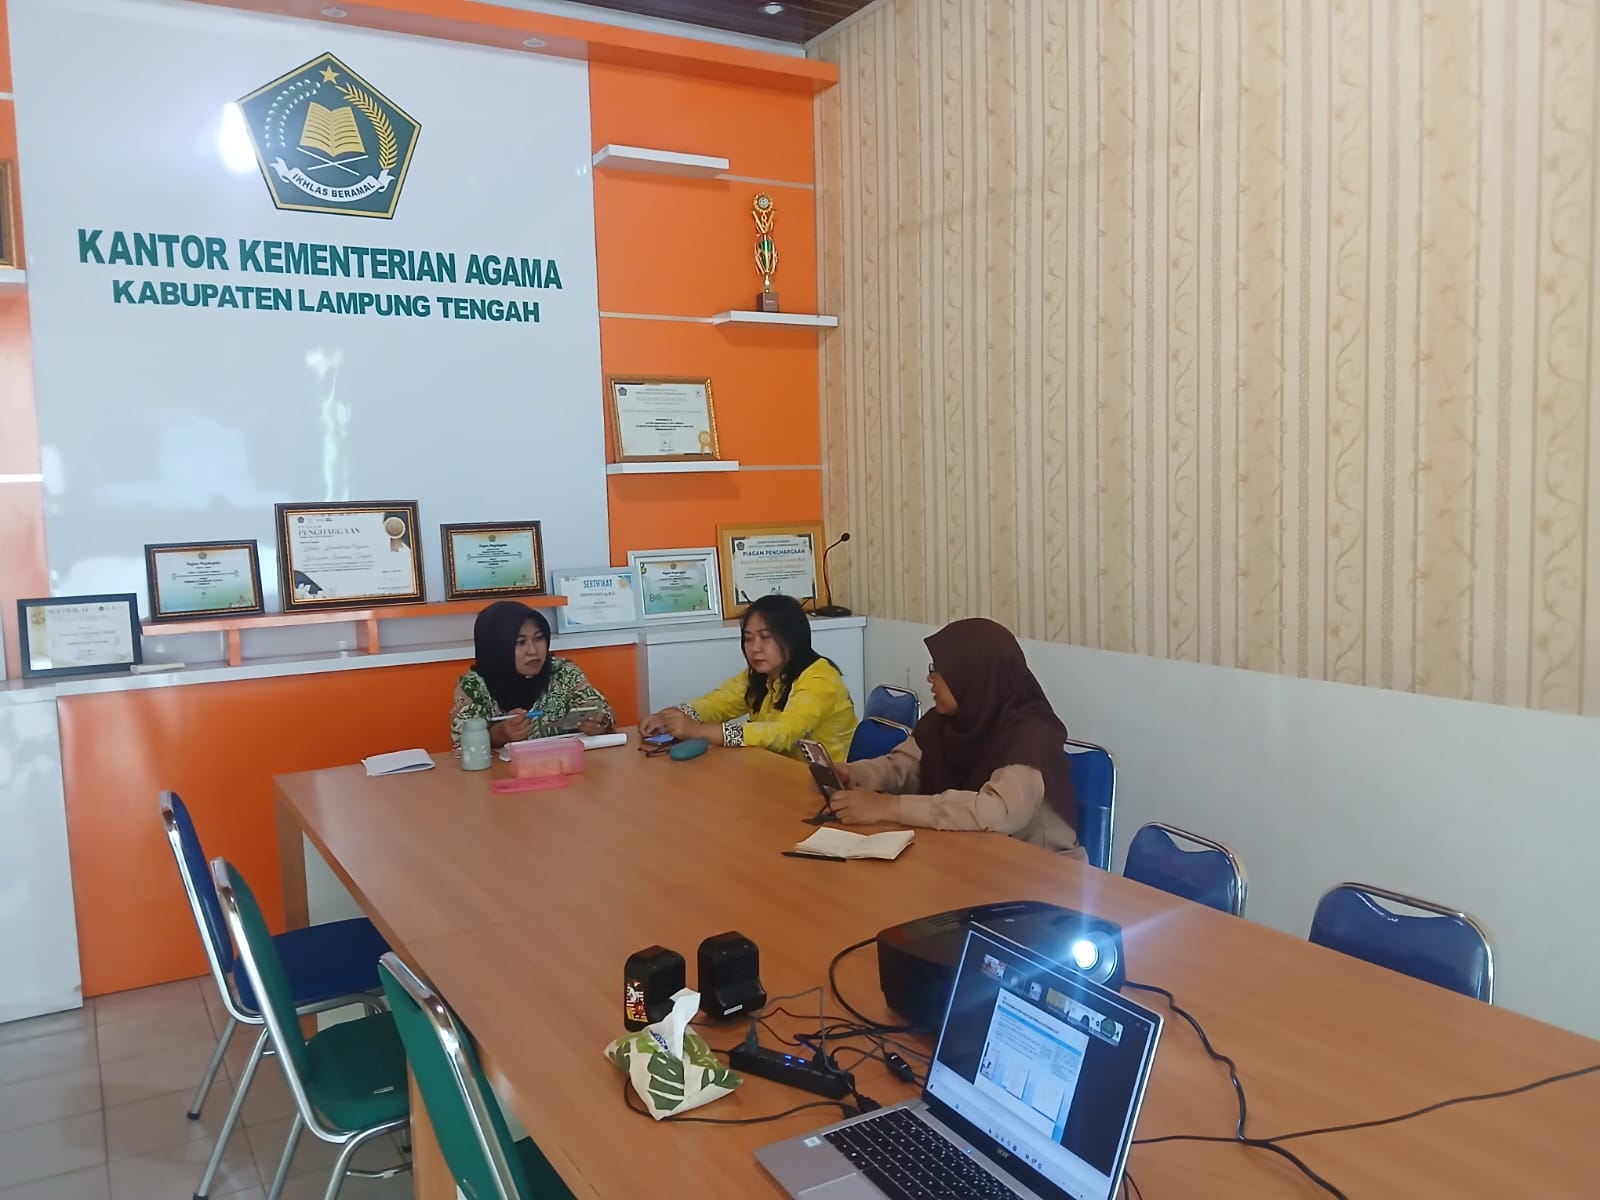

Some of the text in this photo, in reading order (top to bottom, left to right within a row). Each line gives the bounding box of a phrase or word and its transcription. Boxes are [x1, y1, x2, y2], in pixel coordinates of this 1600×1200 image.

[292, 173, 376, 198] IKHLAS BERAMAL
[78, 228, 563, 290] KANTOR KEMENTERIAN AGAMA
[112, 279, 541, 323] KABUPATEN LAMPUNG TENGAH
[583, 578, 613, 589] SERTIFIKAT
